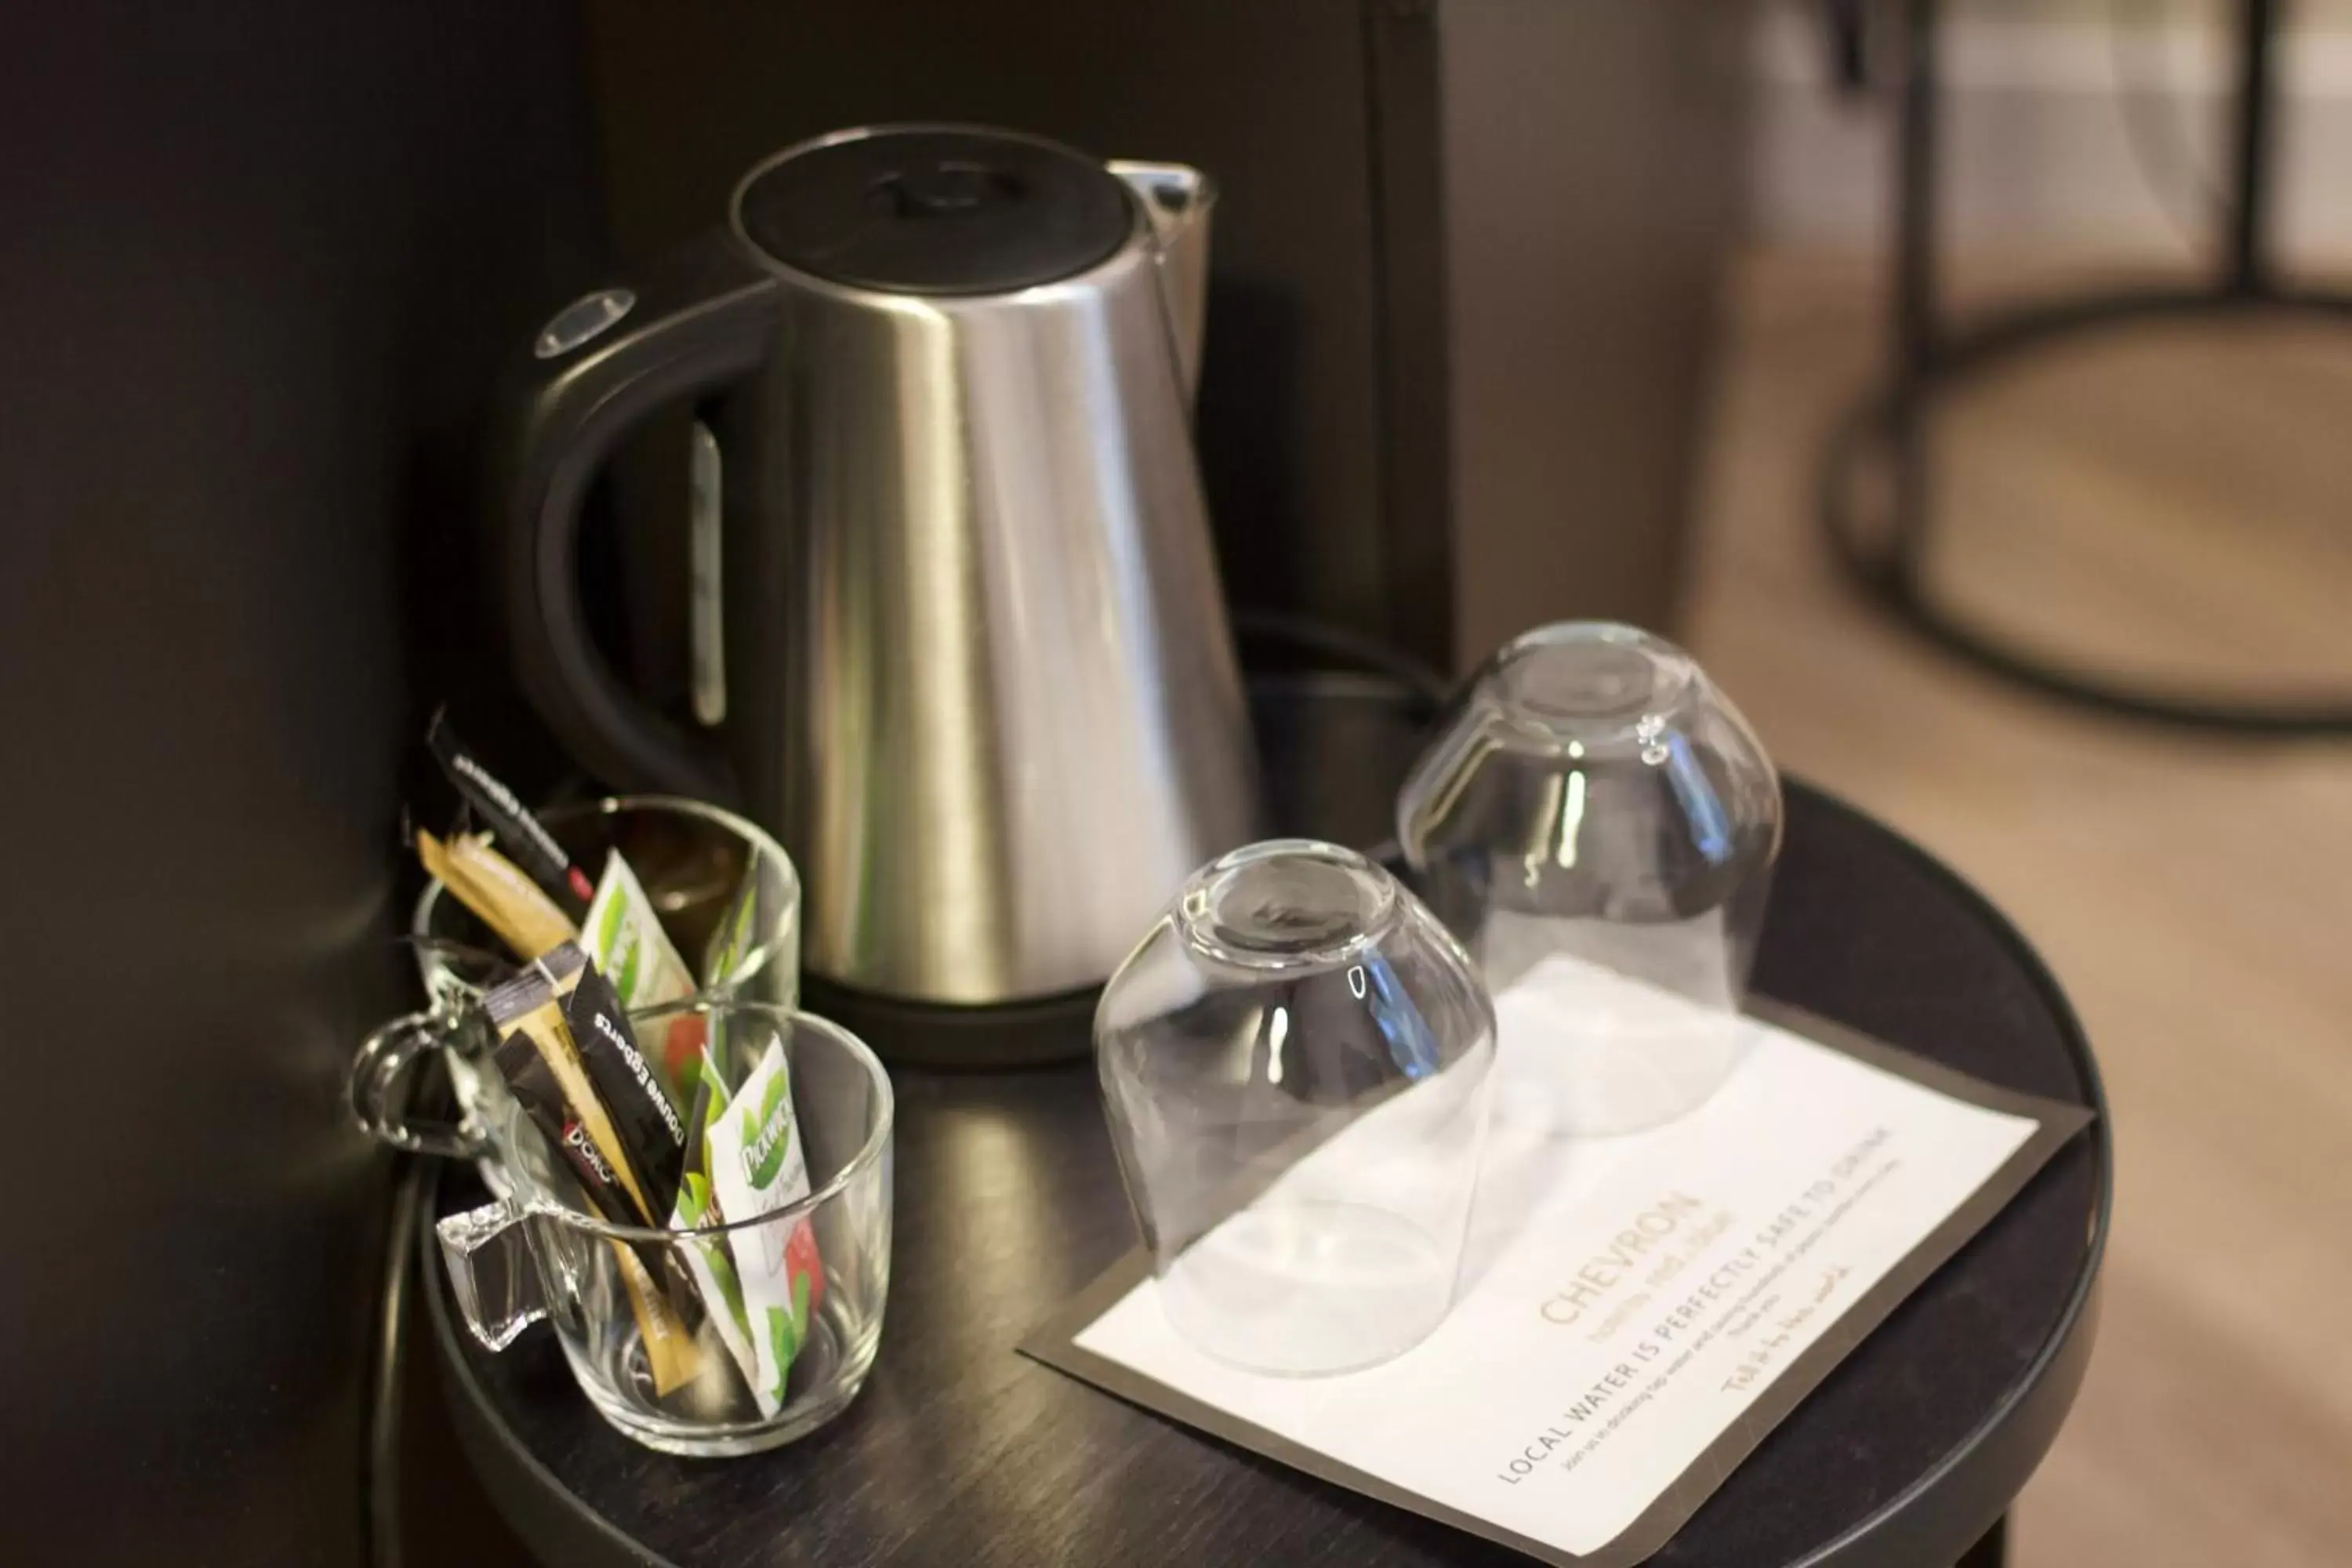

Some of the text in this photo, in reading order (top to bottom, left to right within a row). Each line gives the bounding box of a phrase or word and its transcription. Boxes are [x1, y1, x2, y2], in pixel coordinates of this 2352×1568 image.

[594, 1011, 650, 1086] Egberts
[646, 1079, 685, 1147] Douwe
[1539, 1190, 1701, 1325] CHEVRON
[1497, 1427, 1573, 1485] LOCAL
[1564, 1363, 1639, 1421] WATER
[1632, 1341, 1660, 1362] IS
[1654, 1247, 1761, 1341] PERFECTLY
[1755, 1204, 1813, 1248] SAFE
[1802, 1178, 1836, 1204] TO
